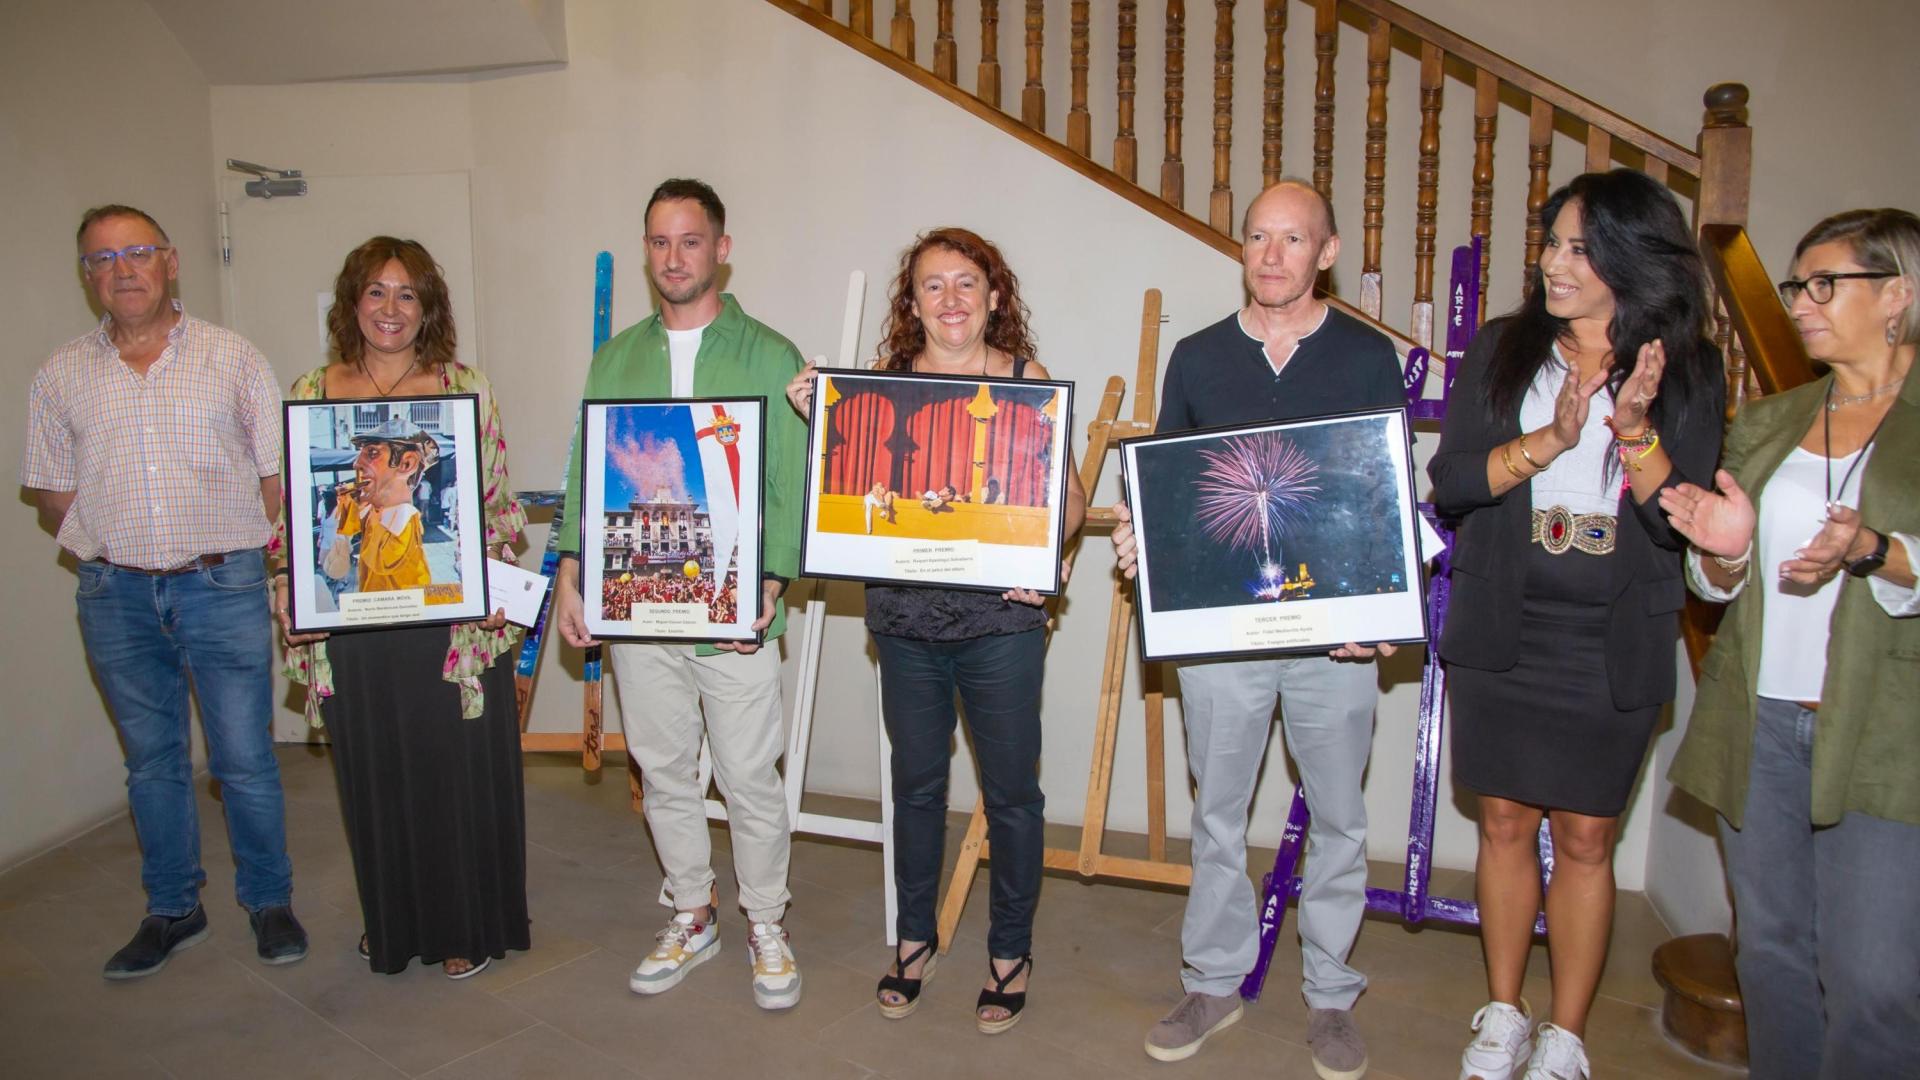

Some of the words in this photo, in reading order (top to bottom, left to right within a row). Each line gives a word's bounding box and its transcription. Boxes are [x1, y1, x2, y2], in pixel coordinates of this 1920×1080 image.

[1454, 282, 1464, 327] ARTE
[1404, 355, 1423, 389] LIST
[1261, 894, 1277, 937] ART
